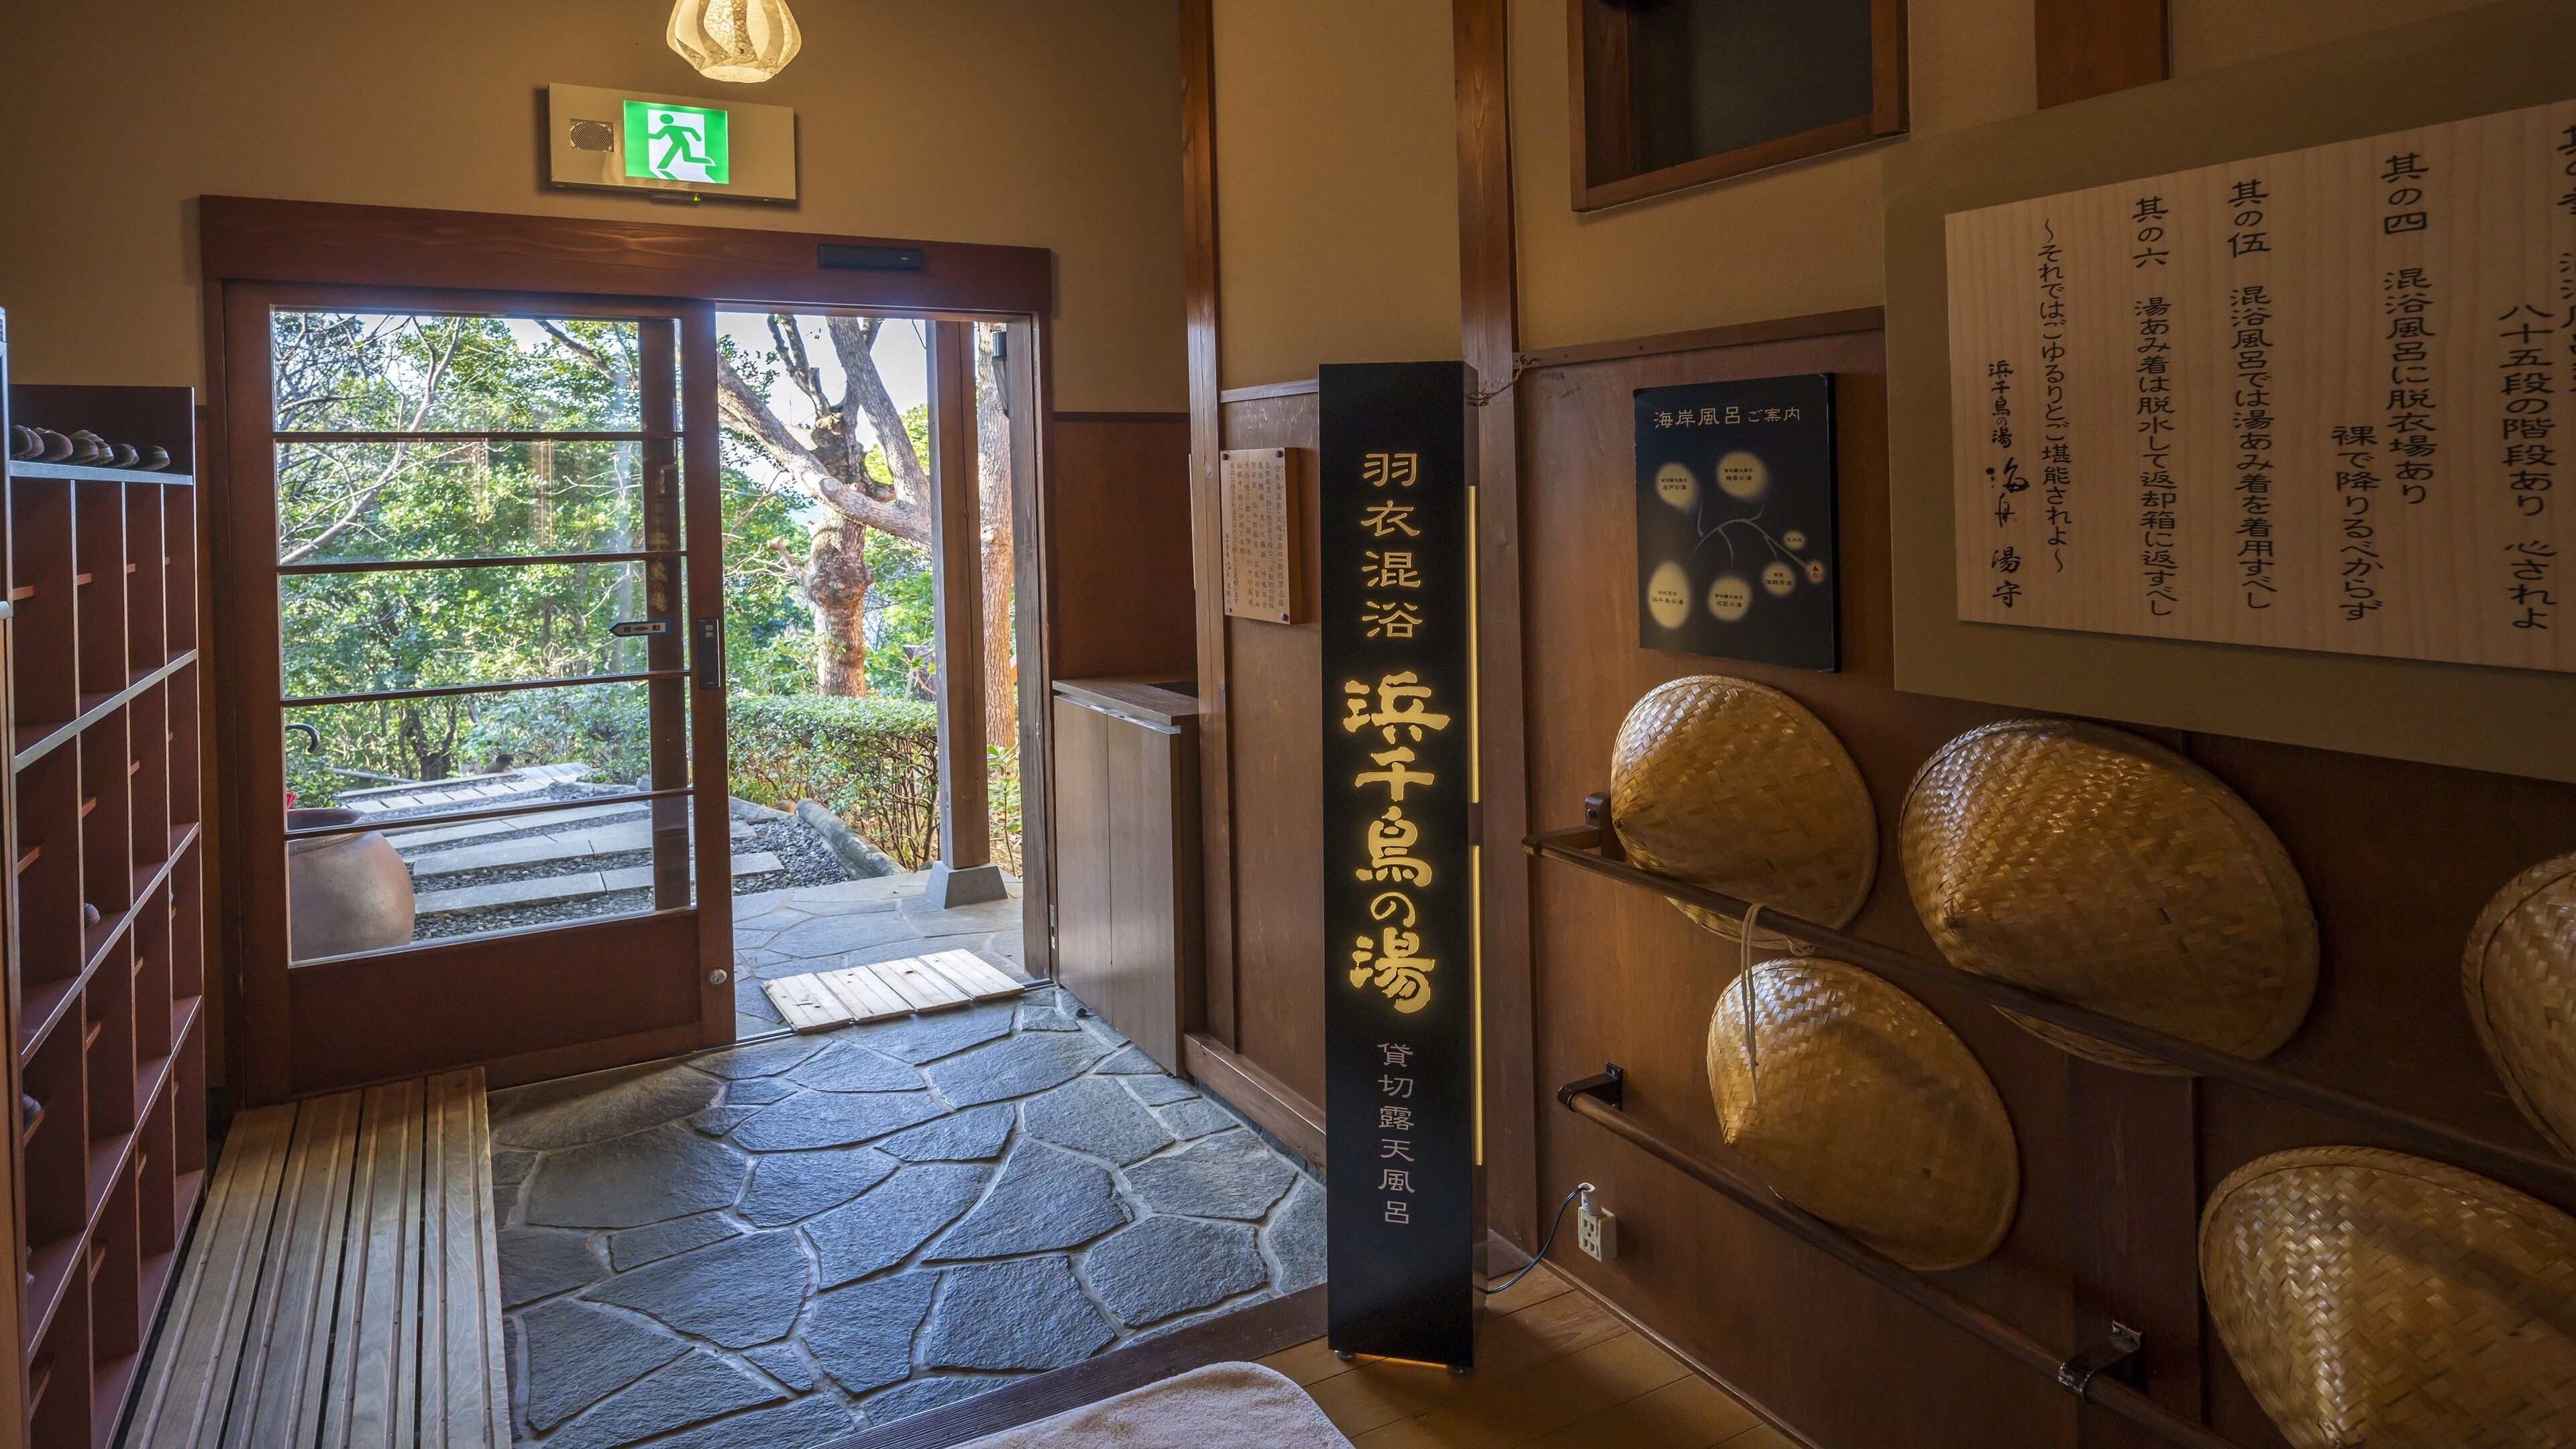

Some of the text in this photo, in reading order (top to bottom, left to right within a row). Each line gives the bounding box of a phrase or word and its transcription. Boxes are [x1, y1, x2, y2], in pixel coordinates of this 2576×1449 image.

[1653, 406, 1801, 429] 海岸風呂ご案内
[1988, 359, 2015, 449] 浜千鳥の湯
[2131, 196, 2178, 616] 其の六 湯あみ着は脱水して返却箱に返すべし
[2226, 178, 2278, 609] 其の伍 混浴風呂では湯あみ着を着用すべし
[2380, 152, 2438, 504] 其の四 混浴風呂に脱衣場あり
[1359, 452, 1424, 639] 羽衣混浴
[2330, 426, 2384, 621] 裸で降りるべからず
[2498, 305, 2558, 629] 八十五段の階段あり 心されよ
[1991, 546, 2022, 608] 湯守
[1342, 670, 1451, 1014] 浜千鳥の湯
[1377, 1042, 1415, 1224] 貸切露天風呂
